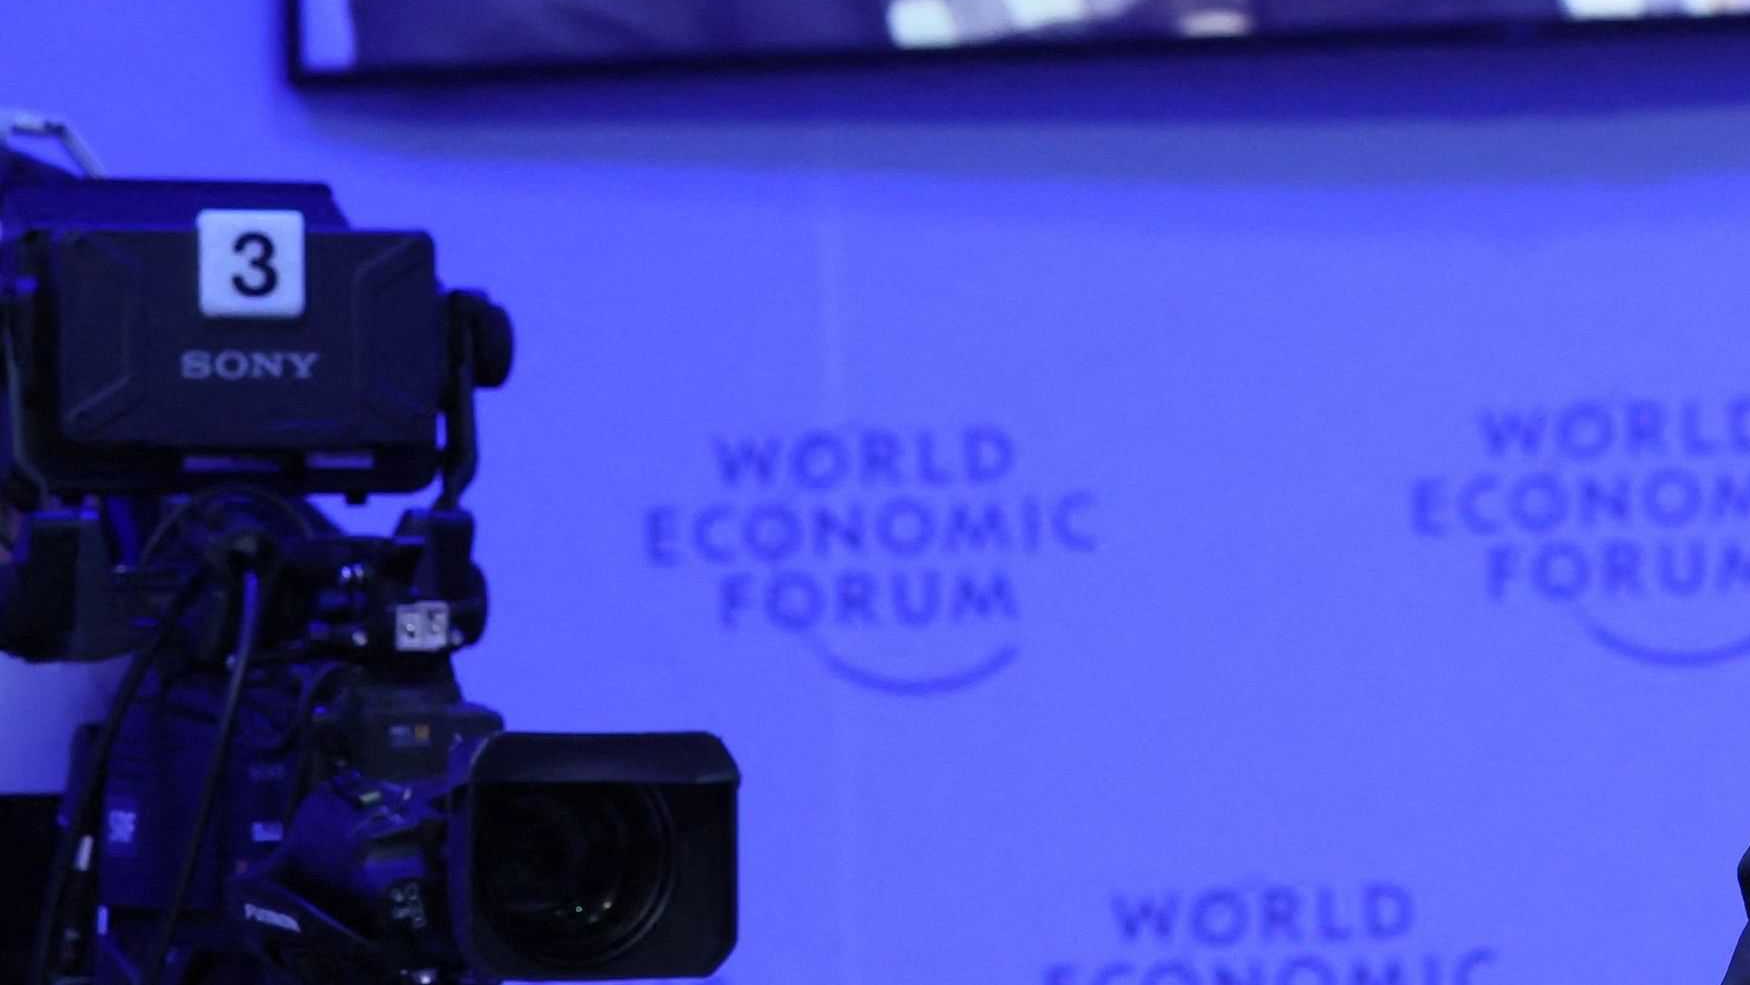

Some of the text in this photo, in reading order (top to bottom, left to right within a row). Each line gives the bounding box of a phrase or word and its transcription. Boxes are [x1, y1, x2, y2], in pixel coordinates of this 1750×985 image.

[232, 231, 278, 298] 3
[180, 348, 319, 380] SONY
[712, 426, 1015, 491] WORLD
[645, 492, 1096, 568] ECONOMIC
[719, 569, 1021, 633] FORUM
[1110, 882, 1416, 948] WORLD
